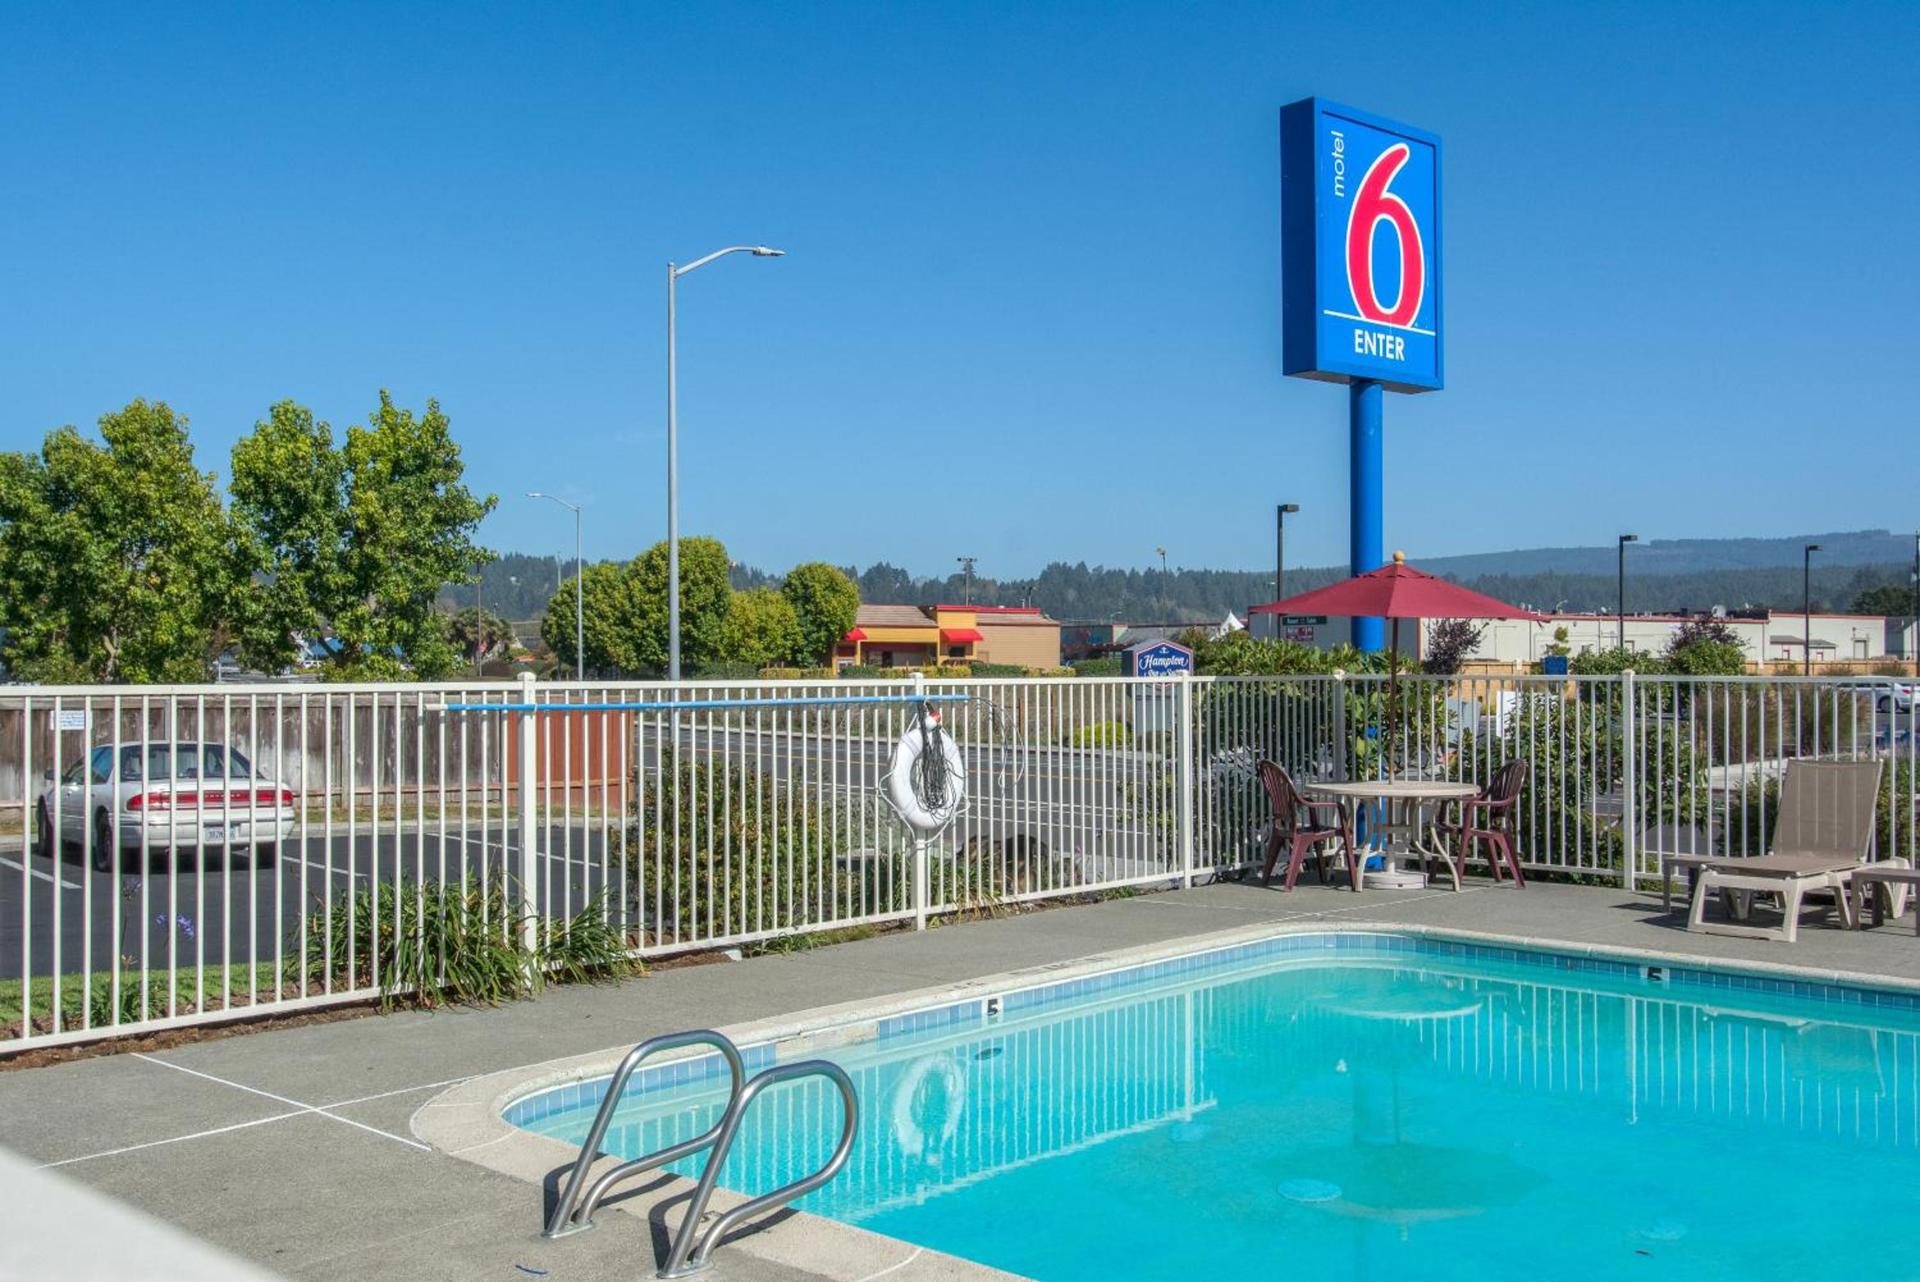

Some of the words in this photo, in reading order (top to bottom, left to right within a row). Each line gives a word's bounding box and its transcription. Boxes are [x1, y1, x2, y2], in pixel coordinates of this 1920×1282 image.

[1331, 130, 1345, 197] motel
[1346, 143, 1425, 327] 6
[1354, 328, 1405, 361] ENTER
[1139, 654, 1188, 670] Hampton
[987, 998, 998, 1016] 5
